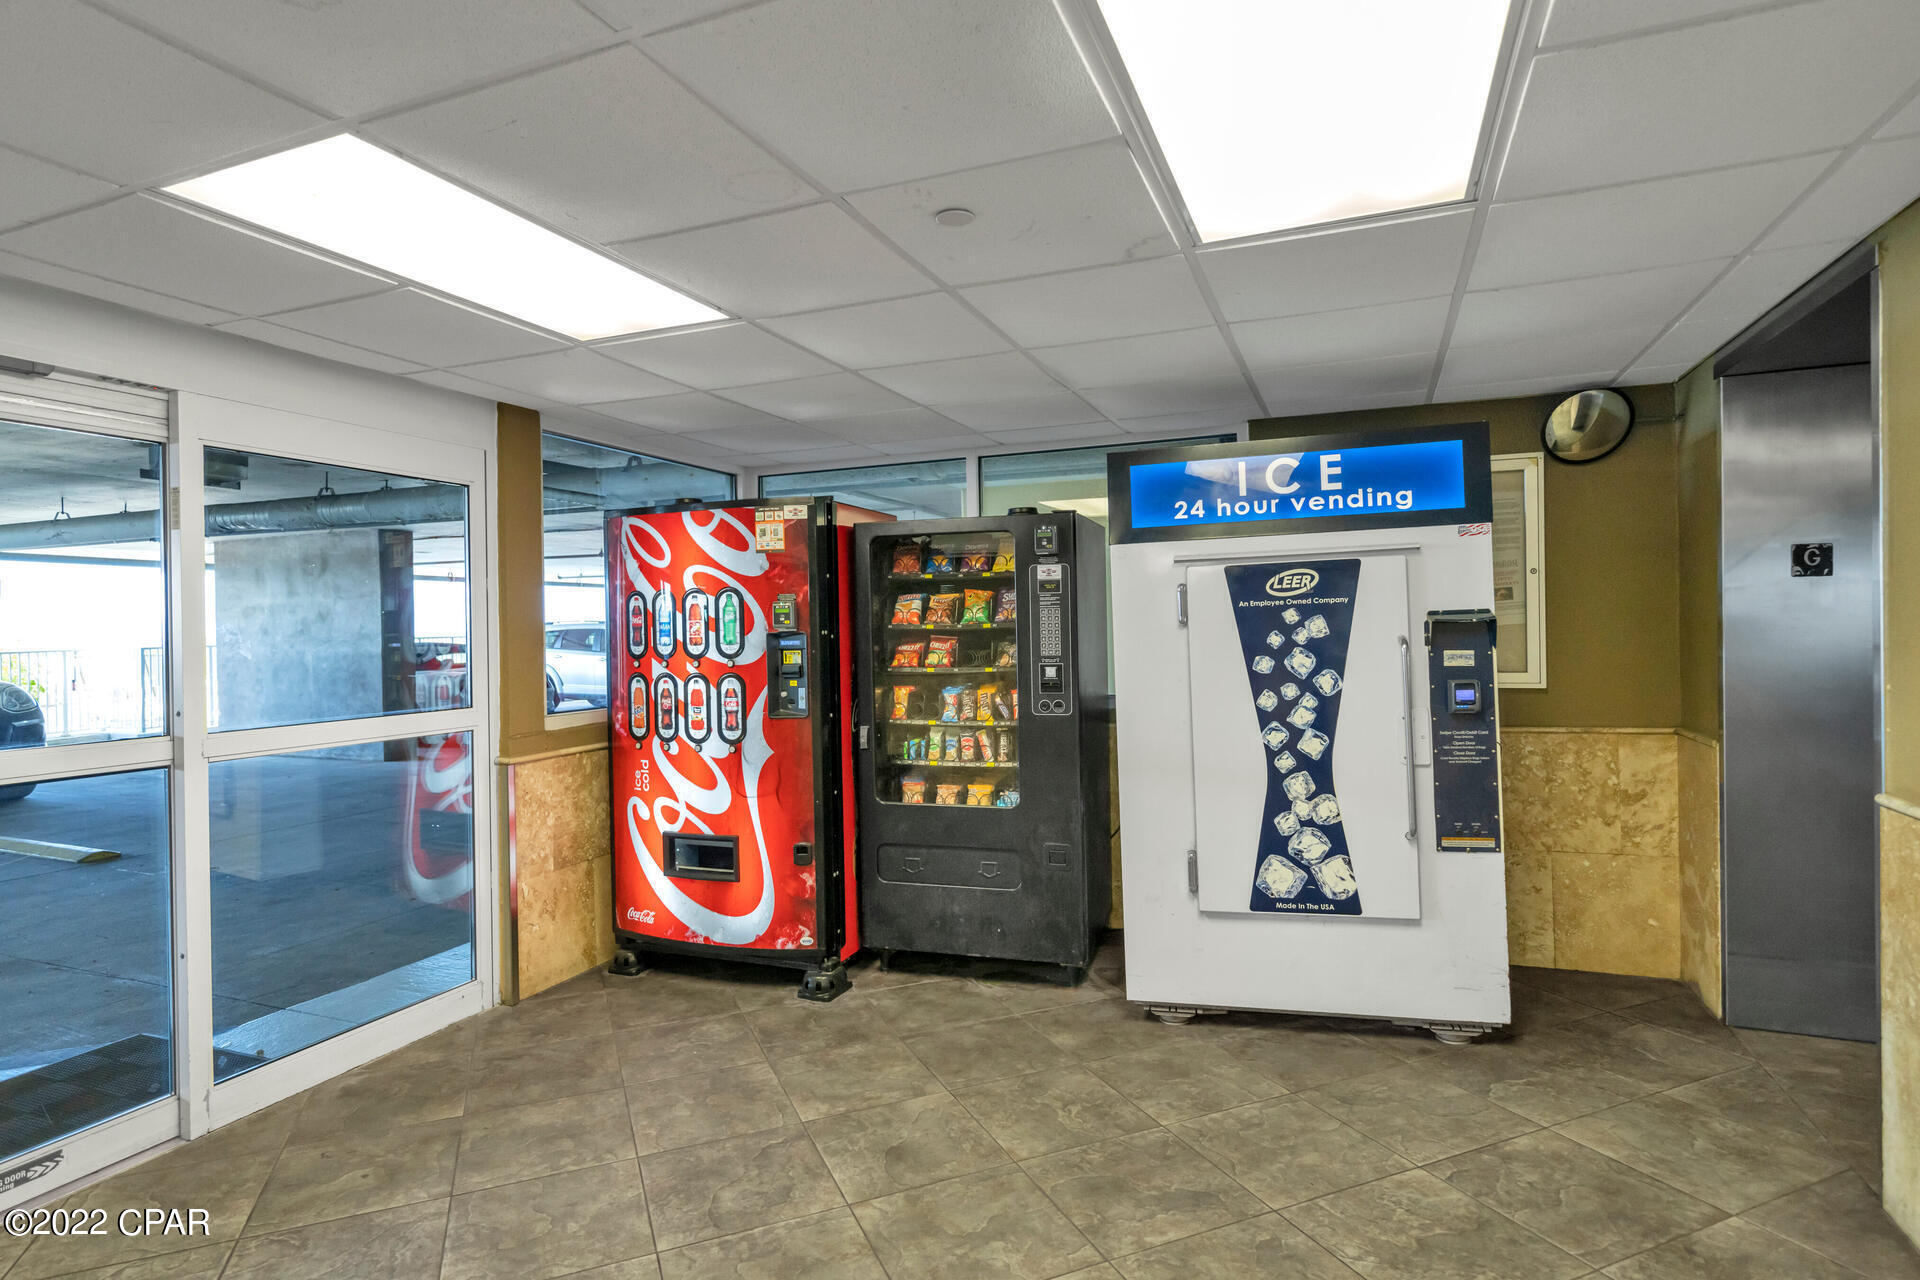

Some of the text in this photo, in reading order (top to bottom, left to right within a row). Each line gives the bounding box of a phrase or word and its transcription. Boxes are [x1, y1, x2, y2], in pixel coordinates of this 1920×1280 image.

[1238, 453, 1343, 497] ICE
[1174, 488, 1413, 520] 24 hour vending
[1803, 548, 1821, 566] G
[1273, 574, 1312, 591] LEER
[1238, 596, 1349, 608] An Employee Owned Company
[640, 759, 650, 792] cold
[1275, 902, 1297, 910] Made
[1320, 903, 1335, 911] USA
[4, 1170, 27, 1185] DOOR
